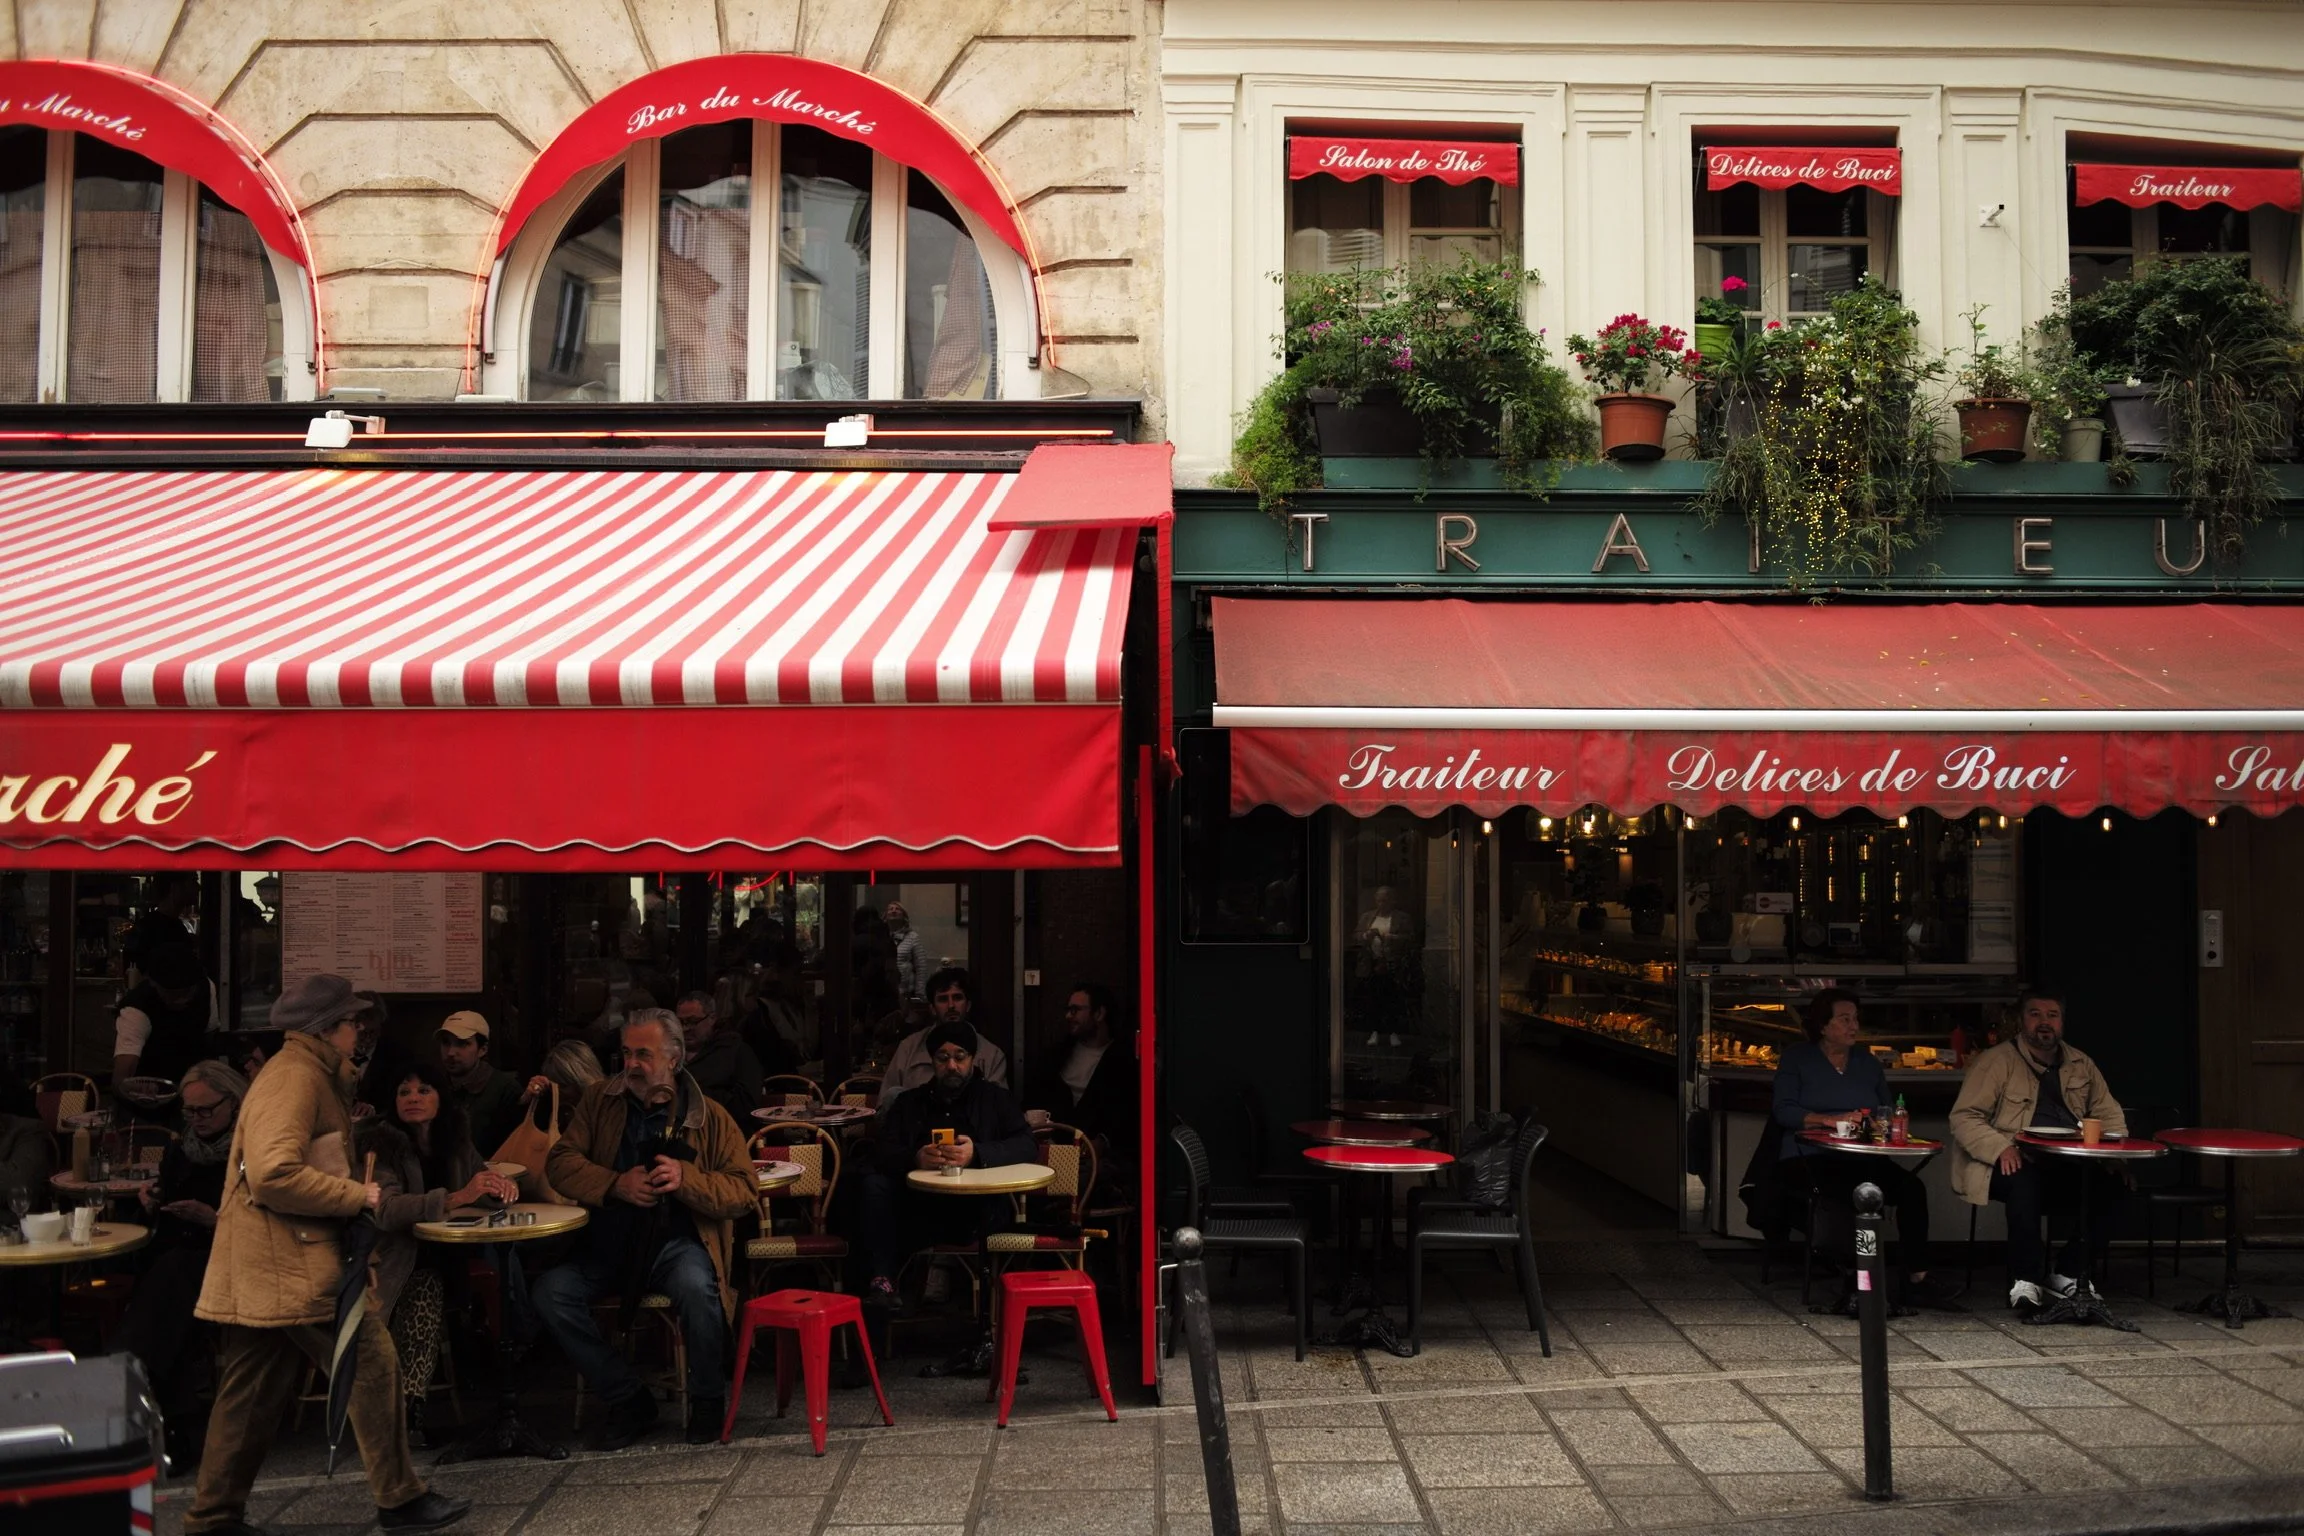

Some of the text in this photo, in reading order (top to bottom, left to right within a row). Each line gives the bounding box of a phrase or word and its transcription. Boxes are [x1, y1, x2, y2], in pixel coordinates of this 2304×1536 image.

[22, 92, 147, 141] Marché
[626, 86, 877, 135] Bar du Marché
[1319, 145, 1487, 172] Salon de Thé
[1710, 153, 1897, 181] Délices de Buci
[2129, 174, 2235, 197] Traiteur
[1338, 744, 1565, 791] Traiteur
[1667, 745, 1856, 792] Delices
[1860, 749, 1928, 792] de
[1936, 745, 2077, 791] Buci
